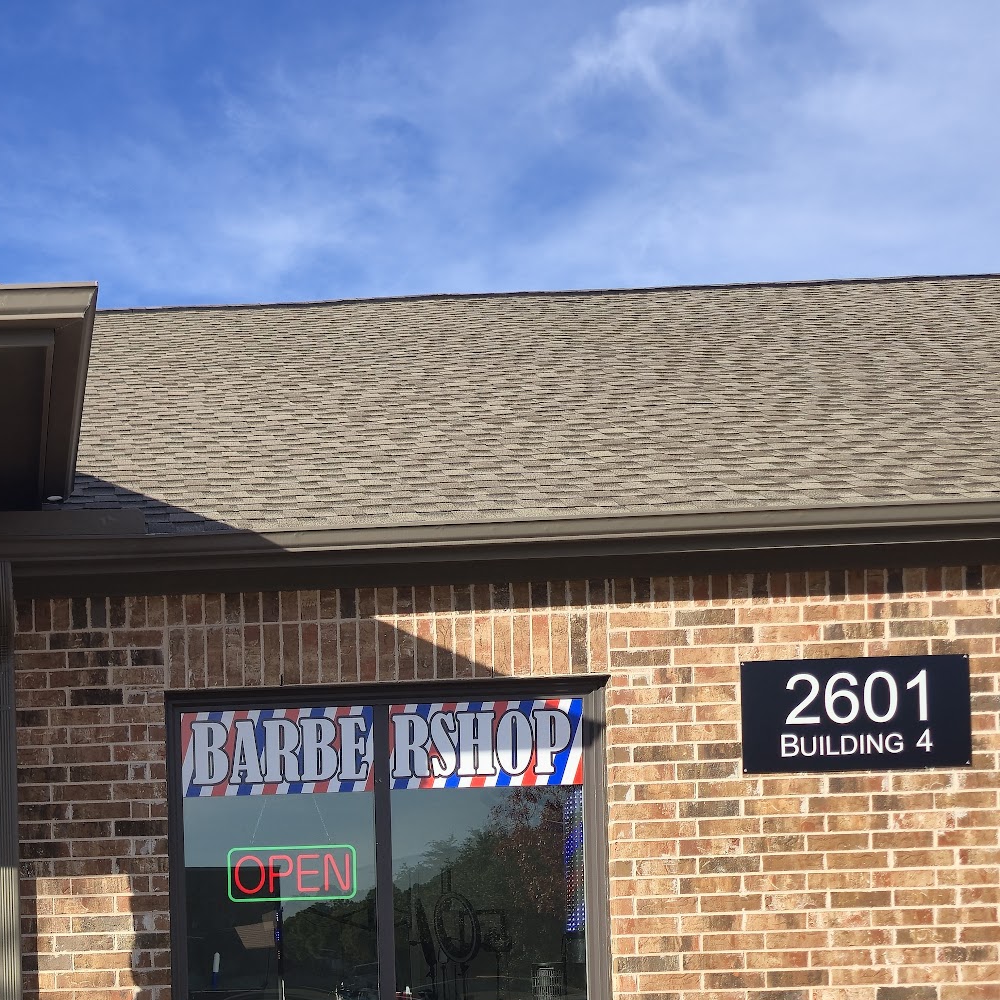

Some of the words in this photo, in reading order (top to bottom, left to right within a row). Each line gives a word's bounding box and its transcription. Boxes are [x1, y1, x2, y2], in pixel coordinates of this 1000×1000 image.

[785, 669, 928, 725] 2601
[780, 732, 904, 758] BUILDING
[916, 729, 933, 752] 4
[234, 852, 351, 894] OPEN
